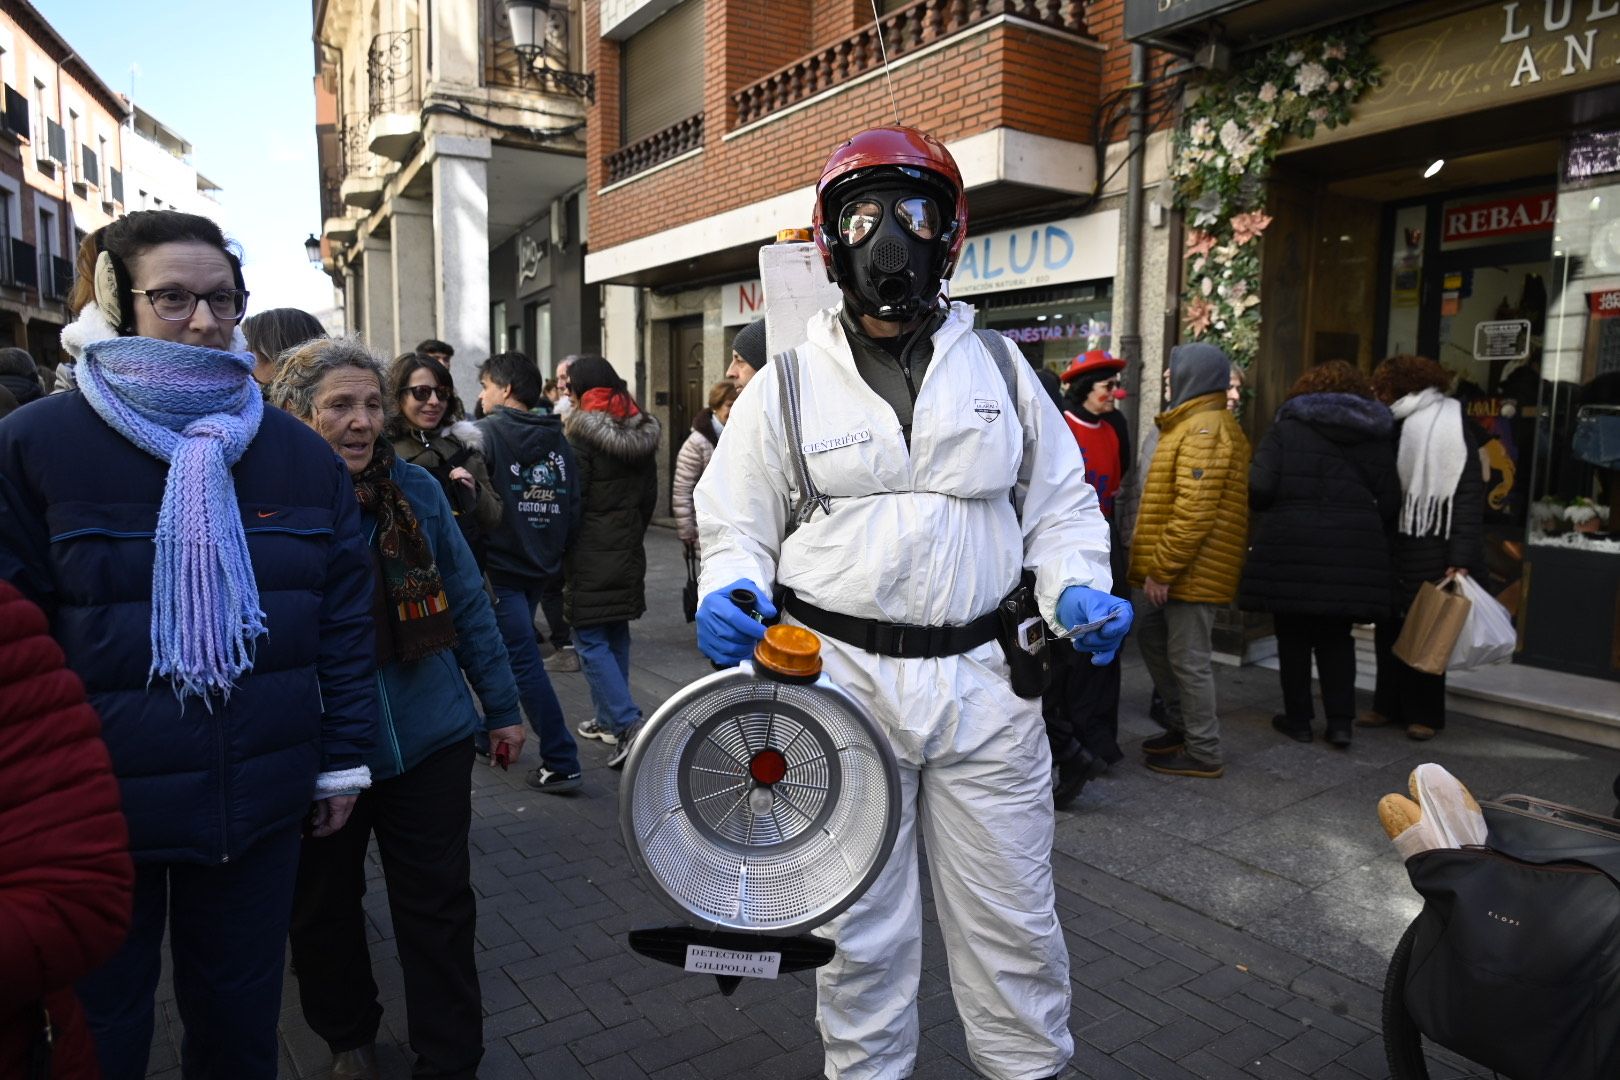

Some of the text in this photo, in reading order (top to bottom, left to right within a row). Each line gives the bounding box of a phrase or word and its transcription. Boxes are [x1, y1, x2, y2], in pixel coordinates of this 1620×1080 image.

[1510, 29, 1620, 88] AN
[518, 502, 547, 514] CUSTOM
[691, 948, 776, 963] DETECTOR DE
[695, 962, 764, 975] GILIPOLLAS
